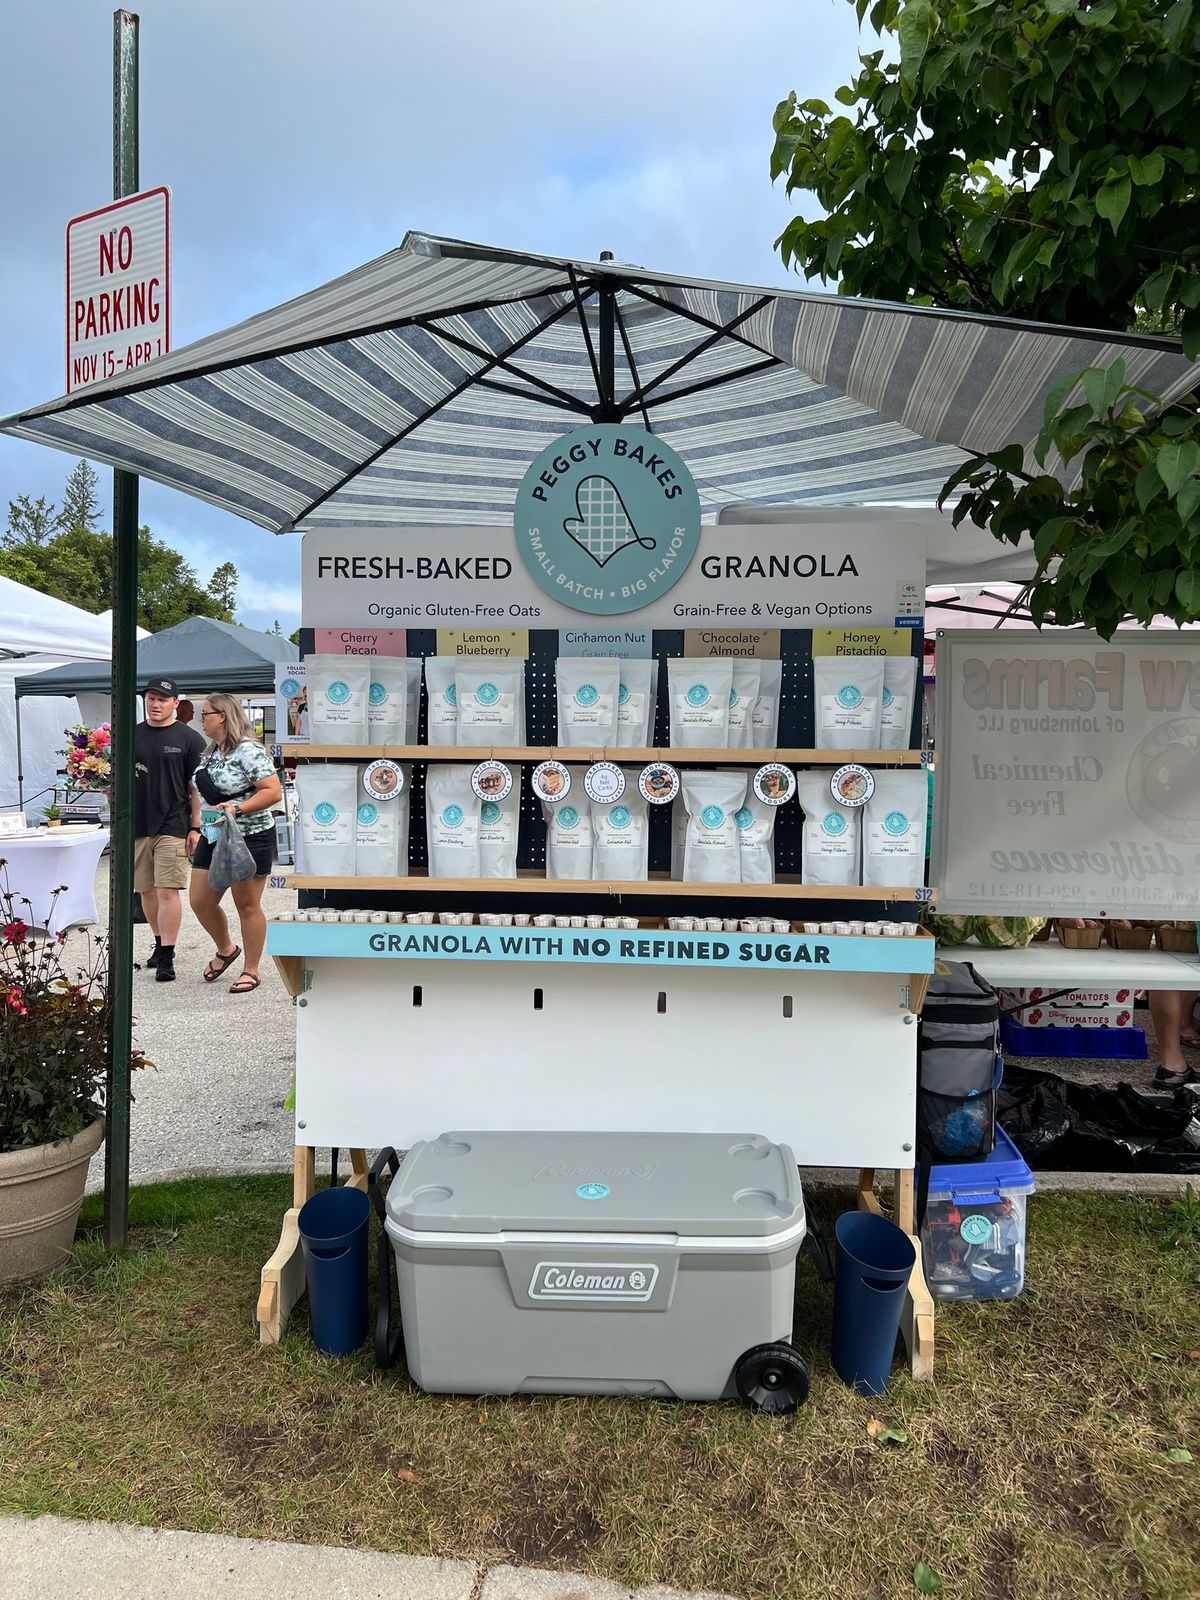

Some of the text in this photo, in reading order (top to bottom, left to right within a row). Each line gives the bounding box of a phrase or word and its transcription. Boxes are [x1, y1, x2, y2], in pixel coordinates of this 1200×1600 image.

[100, 226, 132, 276] NO
[75, 278, 159, 342] PARKING
[74, 354, 97, 385] NOV
[531, 438, 683, 503] PEGGY BAKES
[318, 556, 512, 580] FRESH-BAKED
[528, 526, 686, 600] SMALL BATCH BIG FLAVOR
[701, 554, 859, 579] GRANOLA
[368, 603, 541, 618] Organic Gluten-Free Oats
[673, 602, 872, 619] Grain-Free & Vegan Options
[340, 632, 378, 645] Cherry
[462, 632, 500, 643] Lemon
[565, 632, 646, 643] Cinnamon Nut
[701, 632, 760, 643] Chocolate
[843, 632, 881, 645] Honey
[344, 645, 378, 655] Pecan
[456, 645, 511, 657] Blueberry
[581, 649, 629, 659] Grain Free
[709, 645, 755, 656] Almond
[835, 645, 887, 656] Pistachio
[270, 744, 282, 757] $8
[920, 751, 934, 763] $8
[494, 762, 509, 776] WITH
[661, 764, 677, 779] WITH
[755, 764, 792, 783] GREAT WITH
[855, 765, 871, 780] WITH
[763, 793, 791, 803] YOGURT
[839, 794, 869, 806] SALMON
[270, 877, 287, 889] $12
[915, 888, 933, 902] $12
[368, 932, 831, 964] GRANOLA WITH NO REFINED SUGAR
[1064, 993, 1109, 1001] TOMATOES
[1064, 1016, 1109, 1024] TOMATOES
[543, 1268, 625, 1289] Coleman
